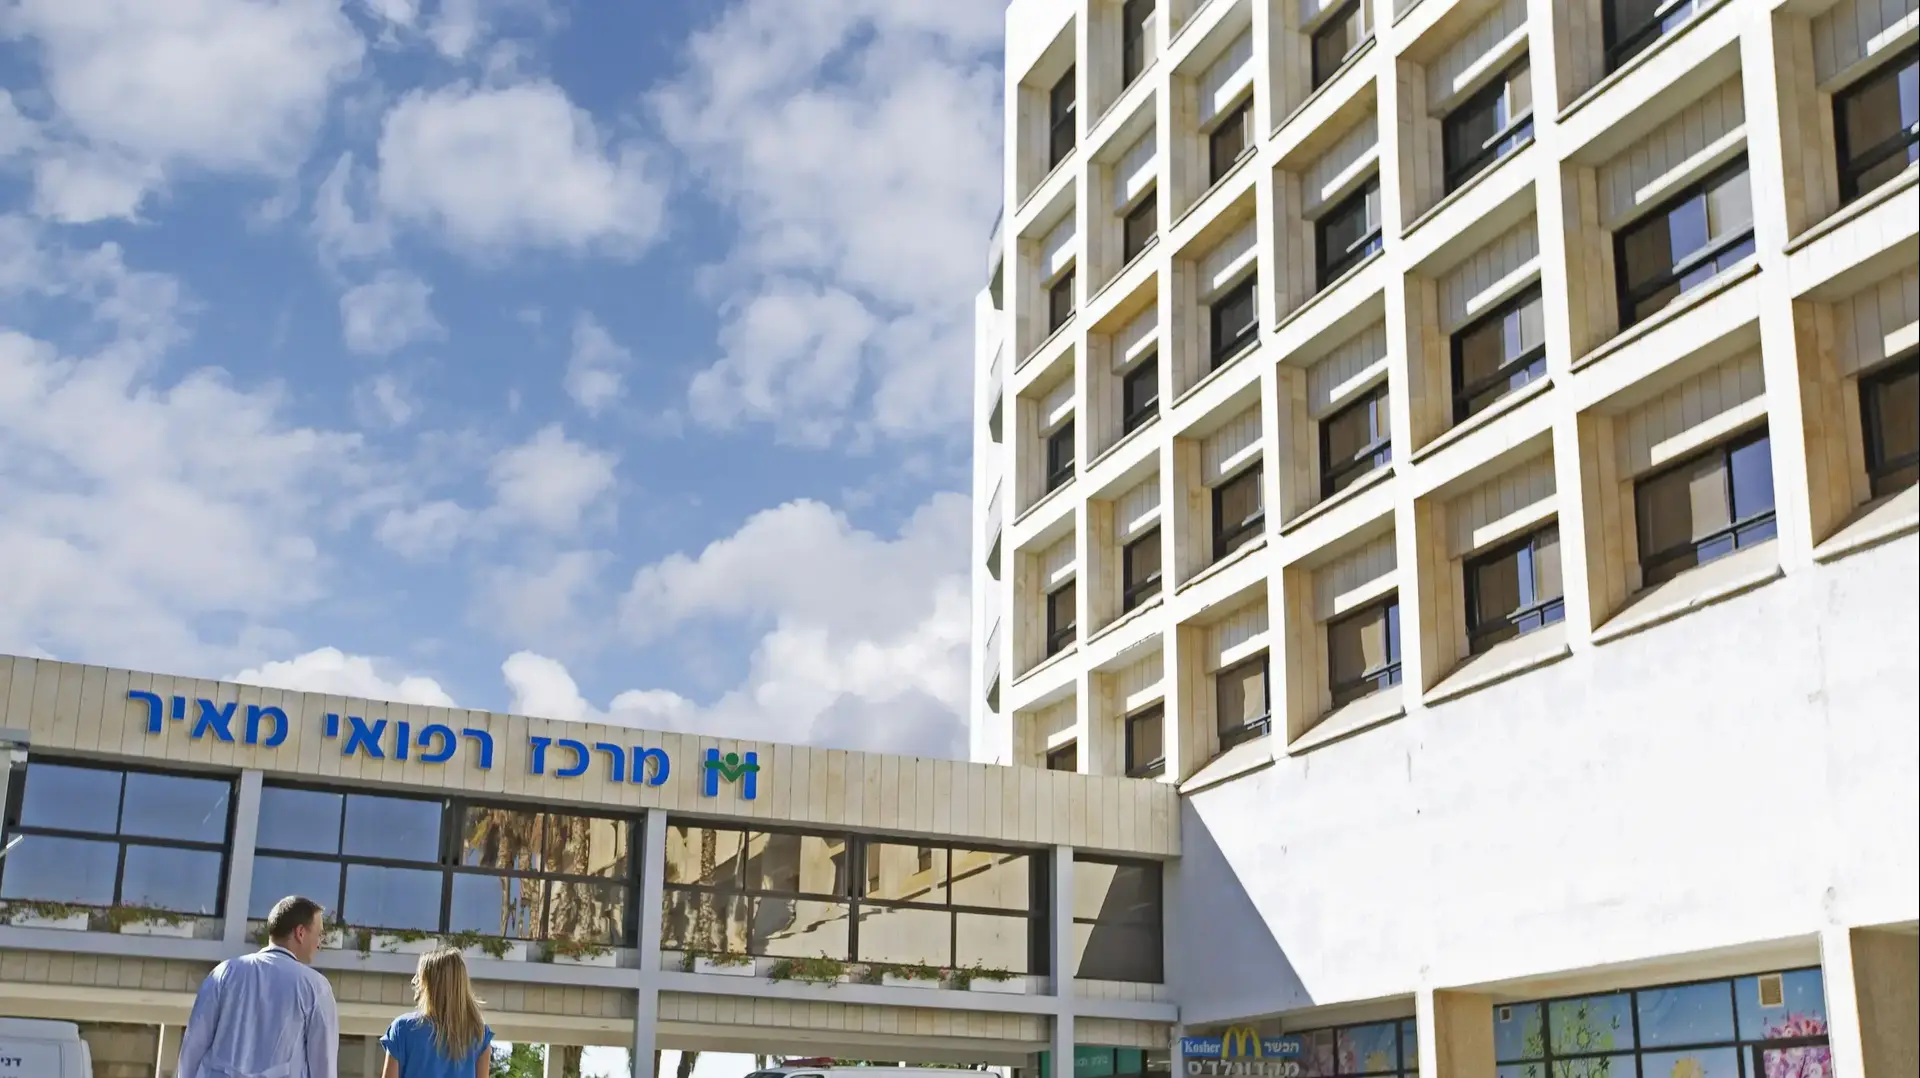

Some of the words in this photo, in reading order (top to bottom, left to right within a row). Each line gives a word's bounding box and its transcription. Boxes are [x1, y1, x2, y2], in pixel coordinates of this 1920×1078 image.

[128, 690, 289, 748] מאיר
[325, 713, 494, 770] רפואי
[530, 735, 671, 787] מרכז
[1185, 1040, 1221, 1053] Kosher
